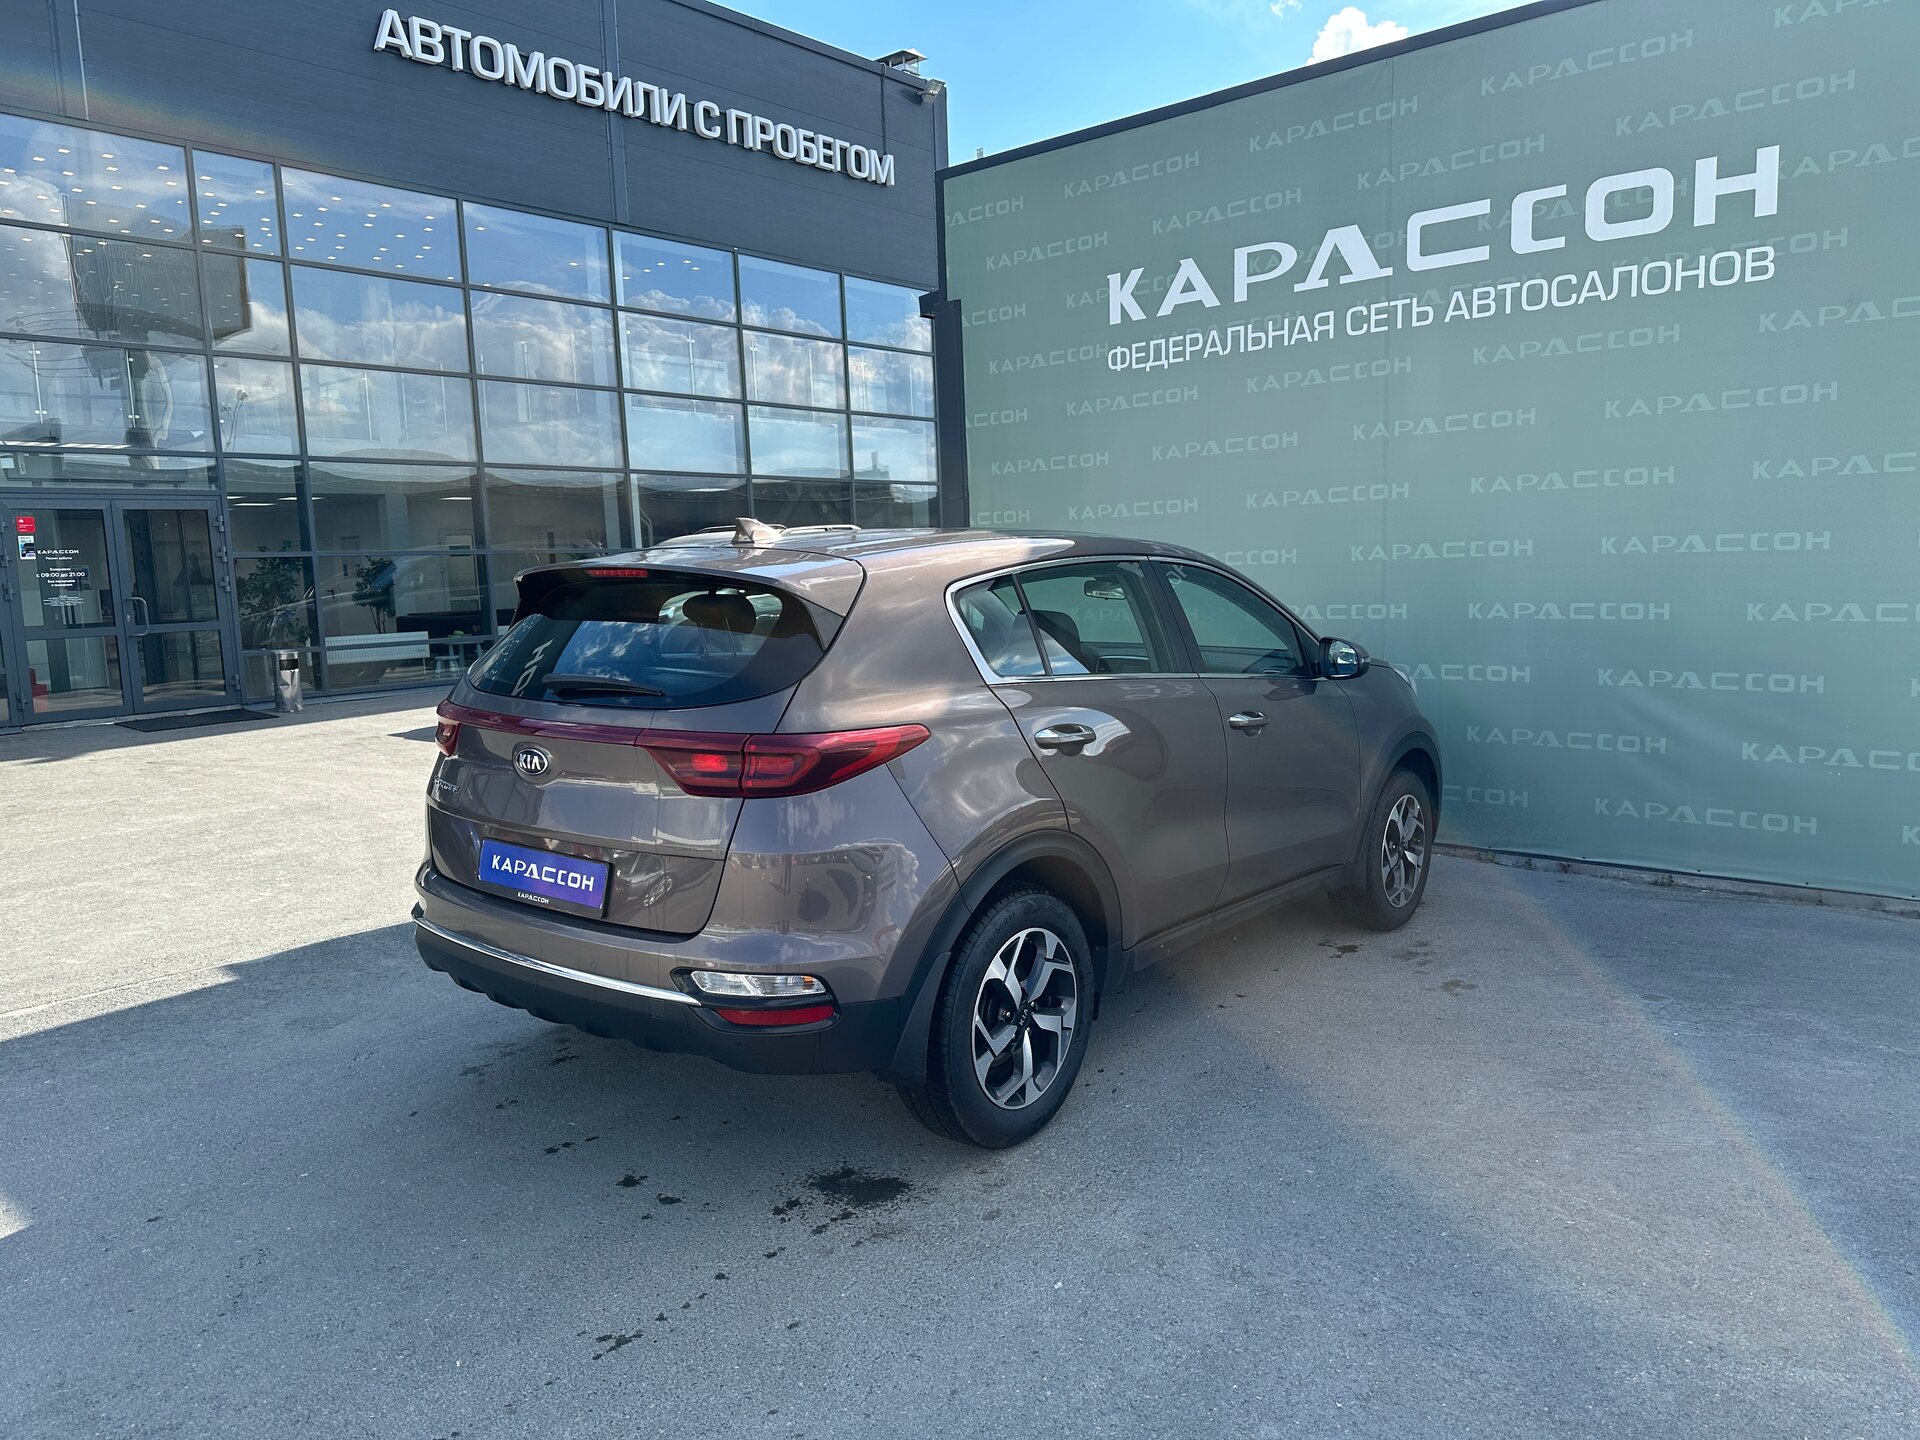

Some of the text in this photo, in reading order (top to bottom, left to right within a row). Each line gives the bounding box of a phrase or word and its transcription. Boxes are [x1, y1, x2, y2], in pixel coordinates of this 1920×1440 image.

[1480, 29, 1694, 97] КАРАССОН
[374, 8, 895, 187] АВТОМОБИЛИ С ПРОБЕГОМ
[1615, 69, 1856, 136] КАРАССОН
[1249, 96, 1418, 153] КАРАССОН
[1064, 151, 1201, 199] КАРАССОН
[1357, 134, 1545, 190] КАРАССОН
[1152, 187, 1301, 235] КАРАССОН
[986, 231, 1108, 271] КАРАССОН
[1107, 145, 1780, 326] КАРАССОН
[1108, 246, 1775, 372] ФЕДЕРАЛЬНАЯ СЕТЬ АВТОСАЛОНОВ
[989, 342, 1109, 375] КАРАССОН
[1472, 324, 1681, 365] КАРАССОН
[1246, 356, 1411, 394] КАРАССОН
[1067, 385, 1198, 417] КАРАССОН
[1606, 381, 1838, 419] КАРАССОН
[1353, 408, 1536, 441] КАРАССОН
[1152, 432, 1298, 462] КАРАССОН
[991, 452, 1109, 476] КАРАССОН
[1470, 465, 1675, 494] КАРАССОН
[1068, 498, 1198, 521] КАРАССОН
[1246, 482, 1409, 509] КАРАССОН
[970, 509, 1030, 525] ССОН
[1206, 548, 1297, 567] ССОН
[1350, 539, 1534, 562] КАРАССОН
[1601, 531, 1831, 554] КАРАССОН
[1468, 602, 1670, 621] КАРАССОН
[1746, 602, 1920, 622] КАРАС
[1598, 668, 1824, 694] КАРАССОН
[1466, 725, 1666, 754] КАРАССОН
[519, 753, 541, 771] KIA
[1594, 797, 1818, 835] КАРАССОН
[491, 854, 595, 892] КАРАССОН
[517, 891, 549, 904] КАРАССОН
[1019, 1009, 1029, 1026] KIA
